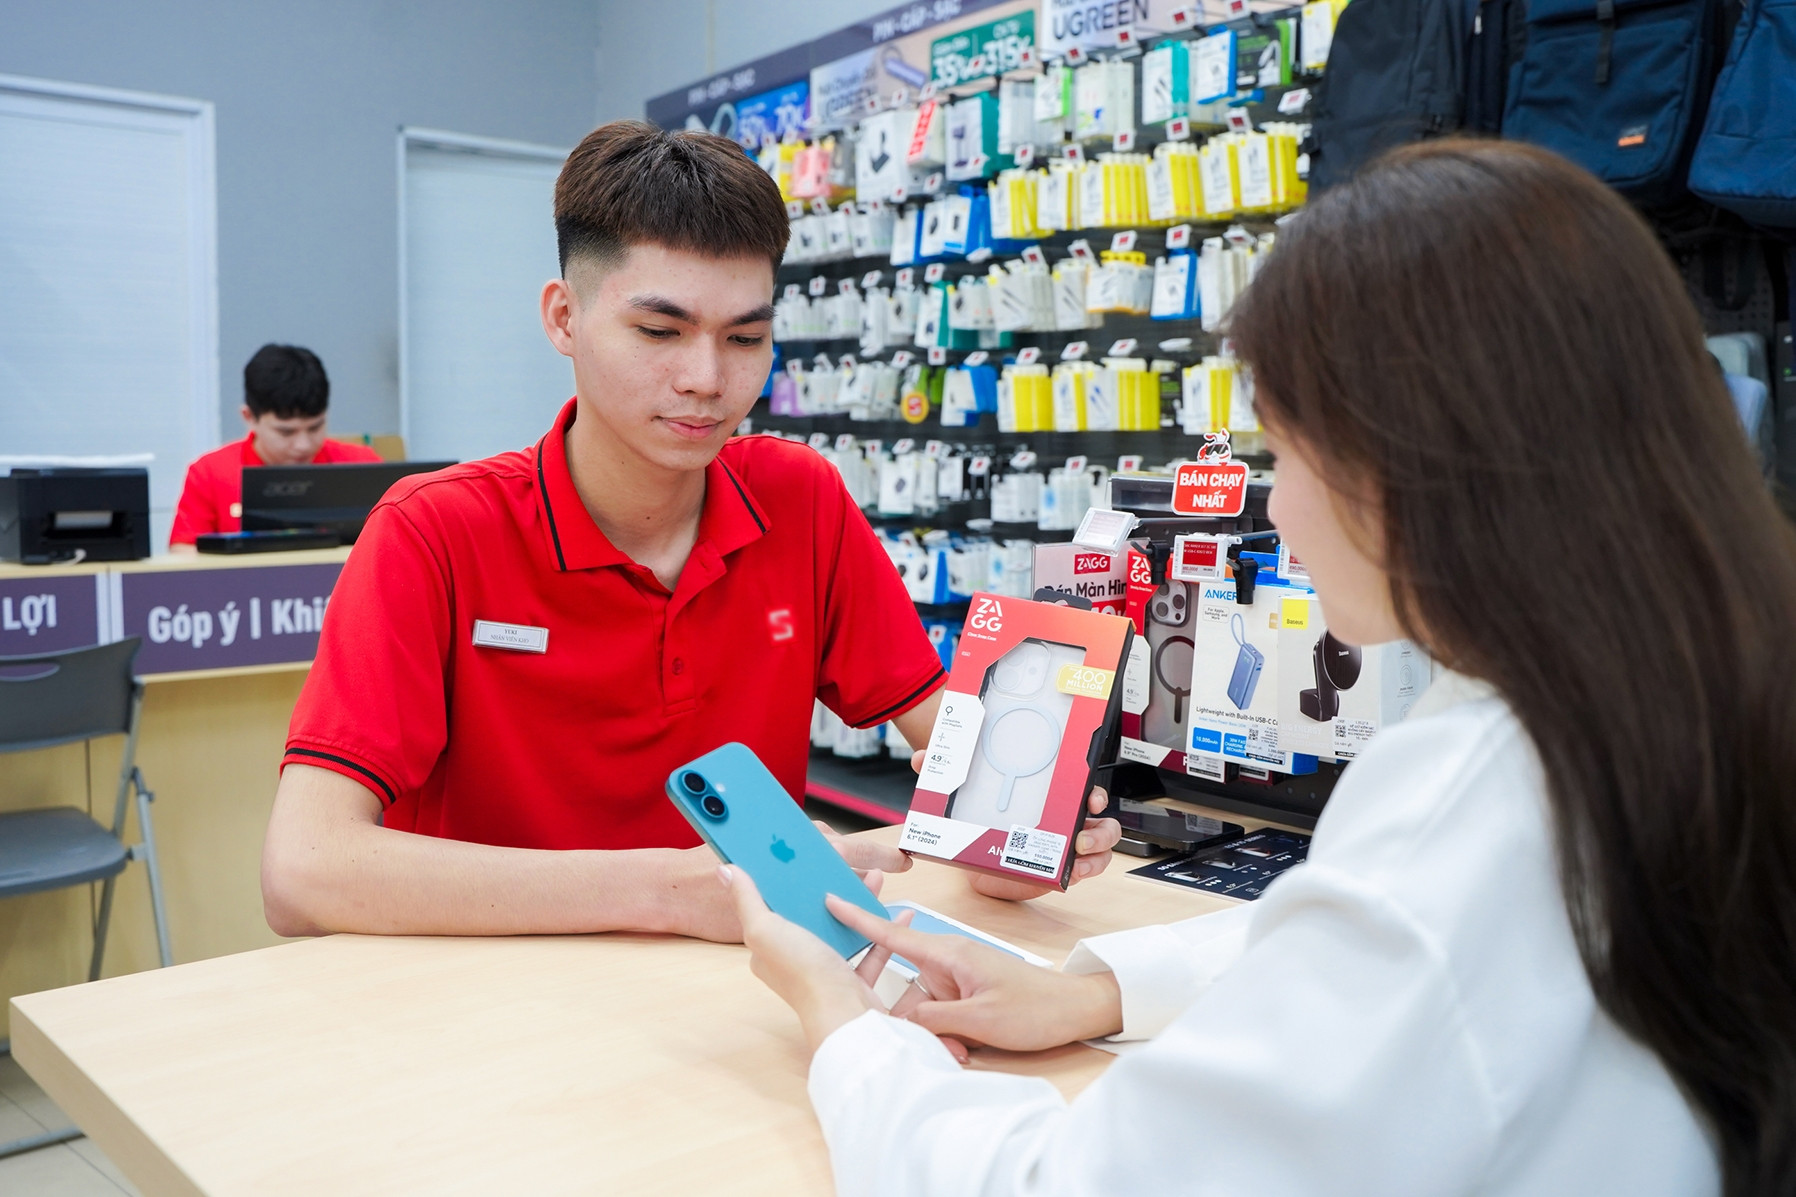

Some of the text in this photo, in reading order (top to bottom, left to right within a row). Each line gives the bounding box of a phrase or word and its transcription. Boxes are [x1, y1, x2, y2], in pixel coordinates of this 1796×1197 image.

[1053, 0, 1149, 40] UGREEN
[1179, 470, 1244, 490] BÁN CHẠY
[1192, 490, 1228, 508] NHẤT
[1076, 556, 1108, 571] ZAGG
[1076, 582, 1105, 598] Màn
[3, 594, 57, 636] LỢI
[148, 604, 213, 648] Góp
[218, 601, 241, 646] ý
[1066, 680, 1103, 692] MILLION
[1072, 670, 1106, 685] 400
[1196, 706, 1224, 716] Lightweight
[1236, 712, 1254, 721] Built-In
[1255, 716, 1272, 724] USB-C
[918, 836, 938, 846] (2024)
[922, 830, 941, 839] iPhone
